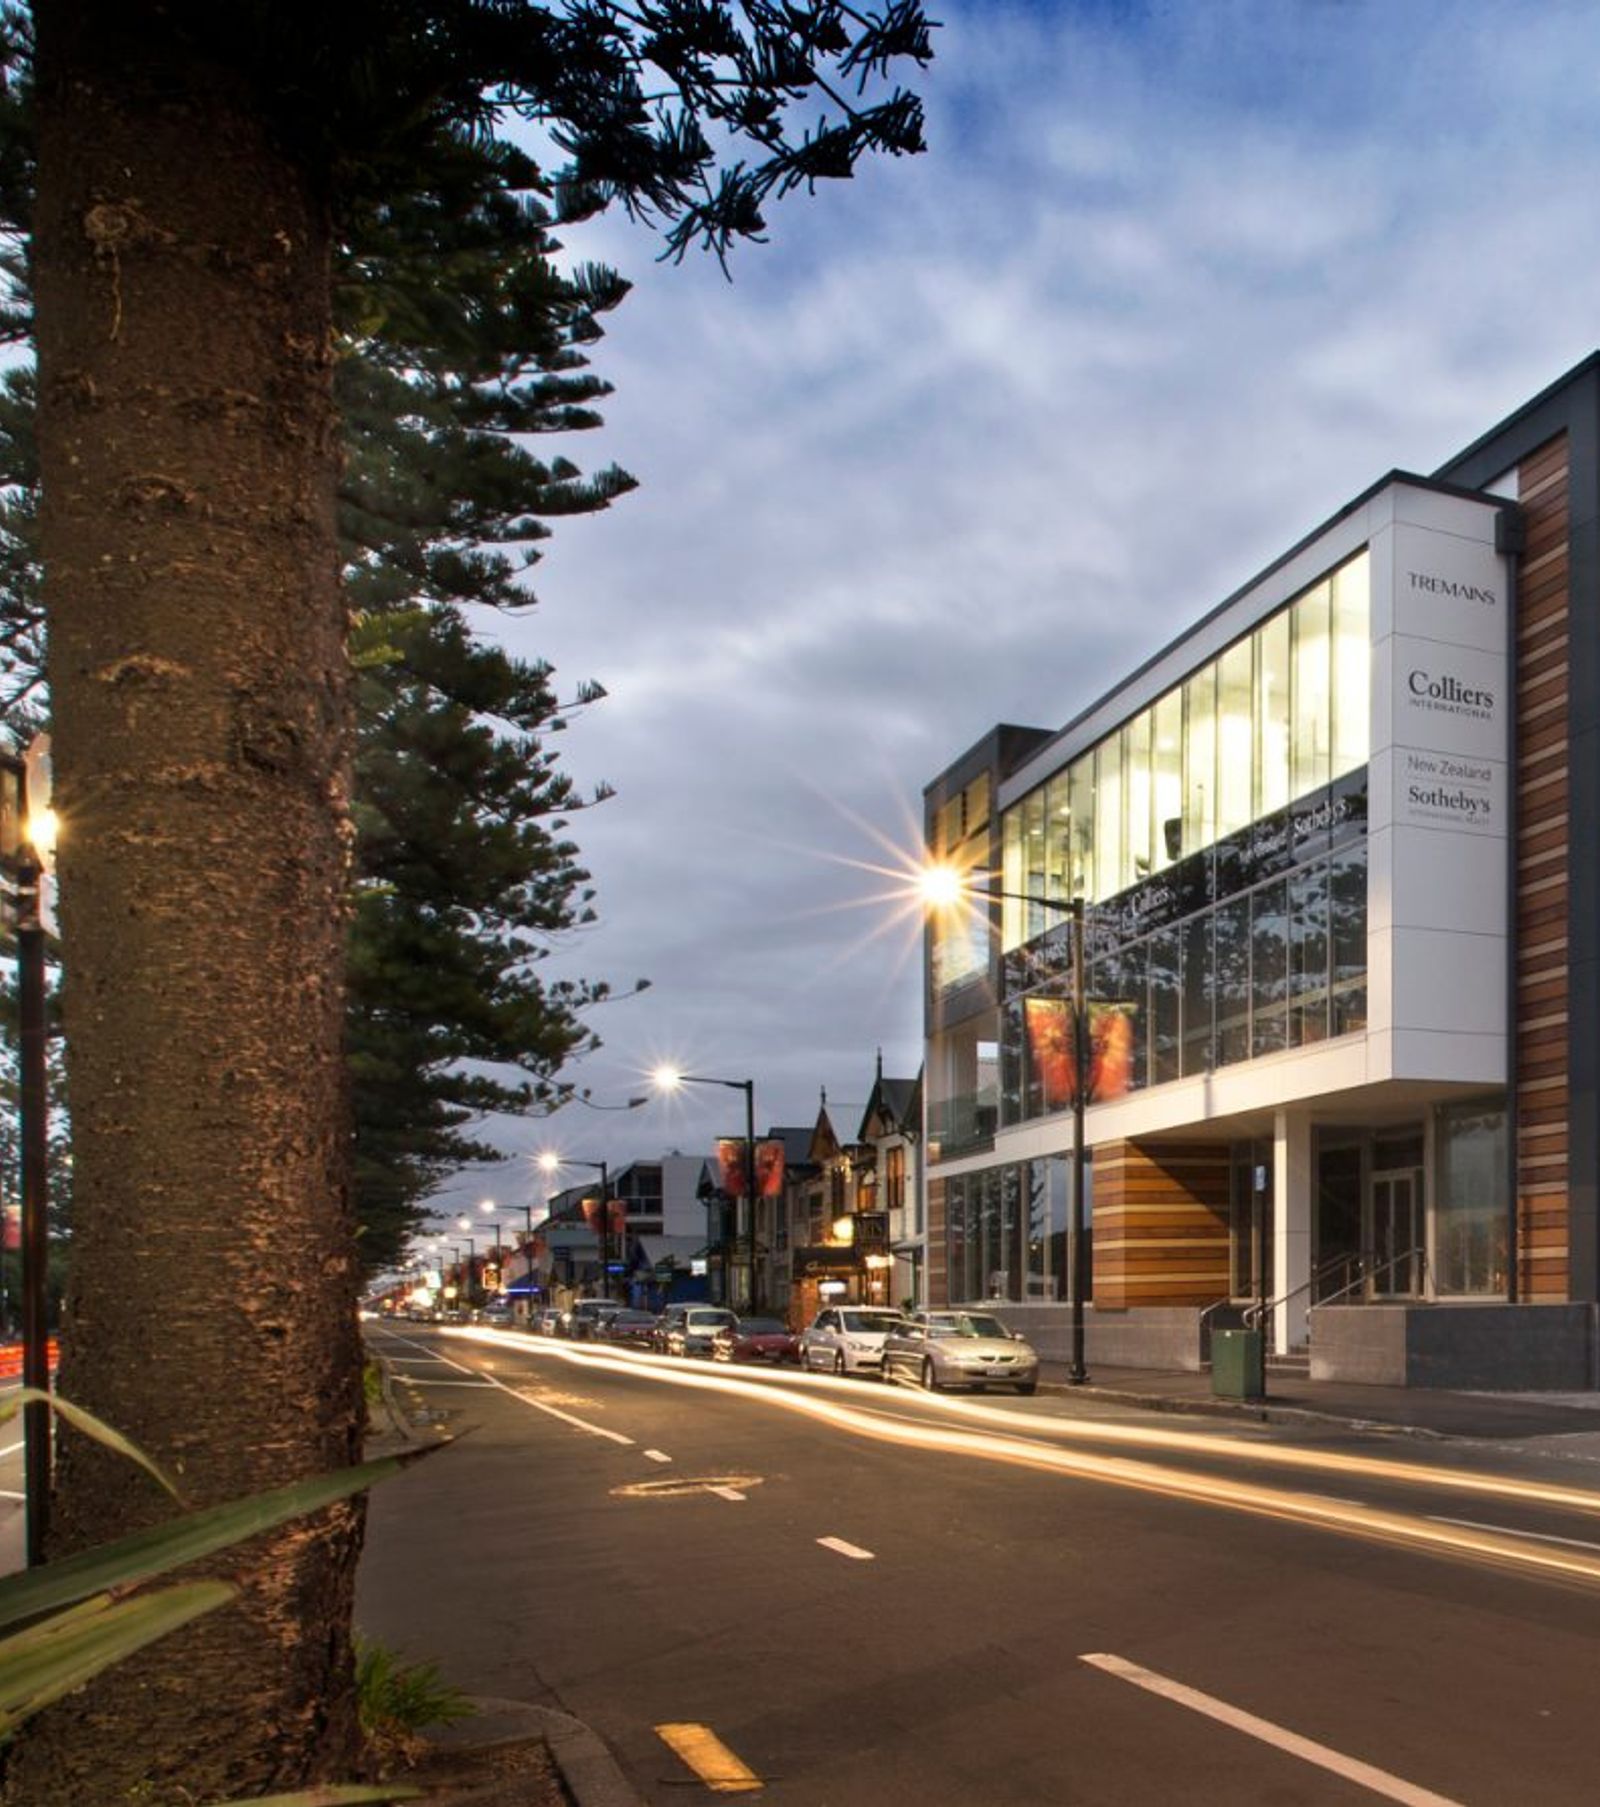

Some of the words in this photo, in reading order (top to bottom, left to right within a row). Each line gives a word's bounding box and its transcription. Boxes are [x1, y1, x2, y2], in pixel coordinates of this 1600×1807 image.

[1408, 572, 1496, 605] TREMAINS
[1409, 670, 1494, 709] Colliers
[1408, 755, 1436, 773] New
[1439, 760, 1492, 781] Zealand
[1408, 785, 1491, 815] Sotheby's
